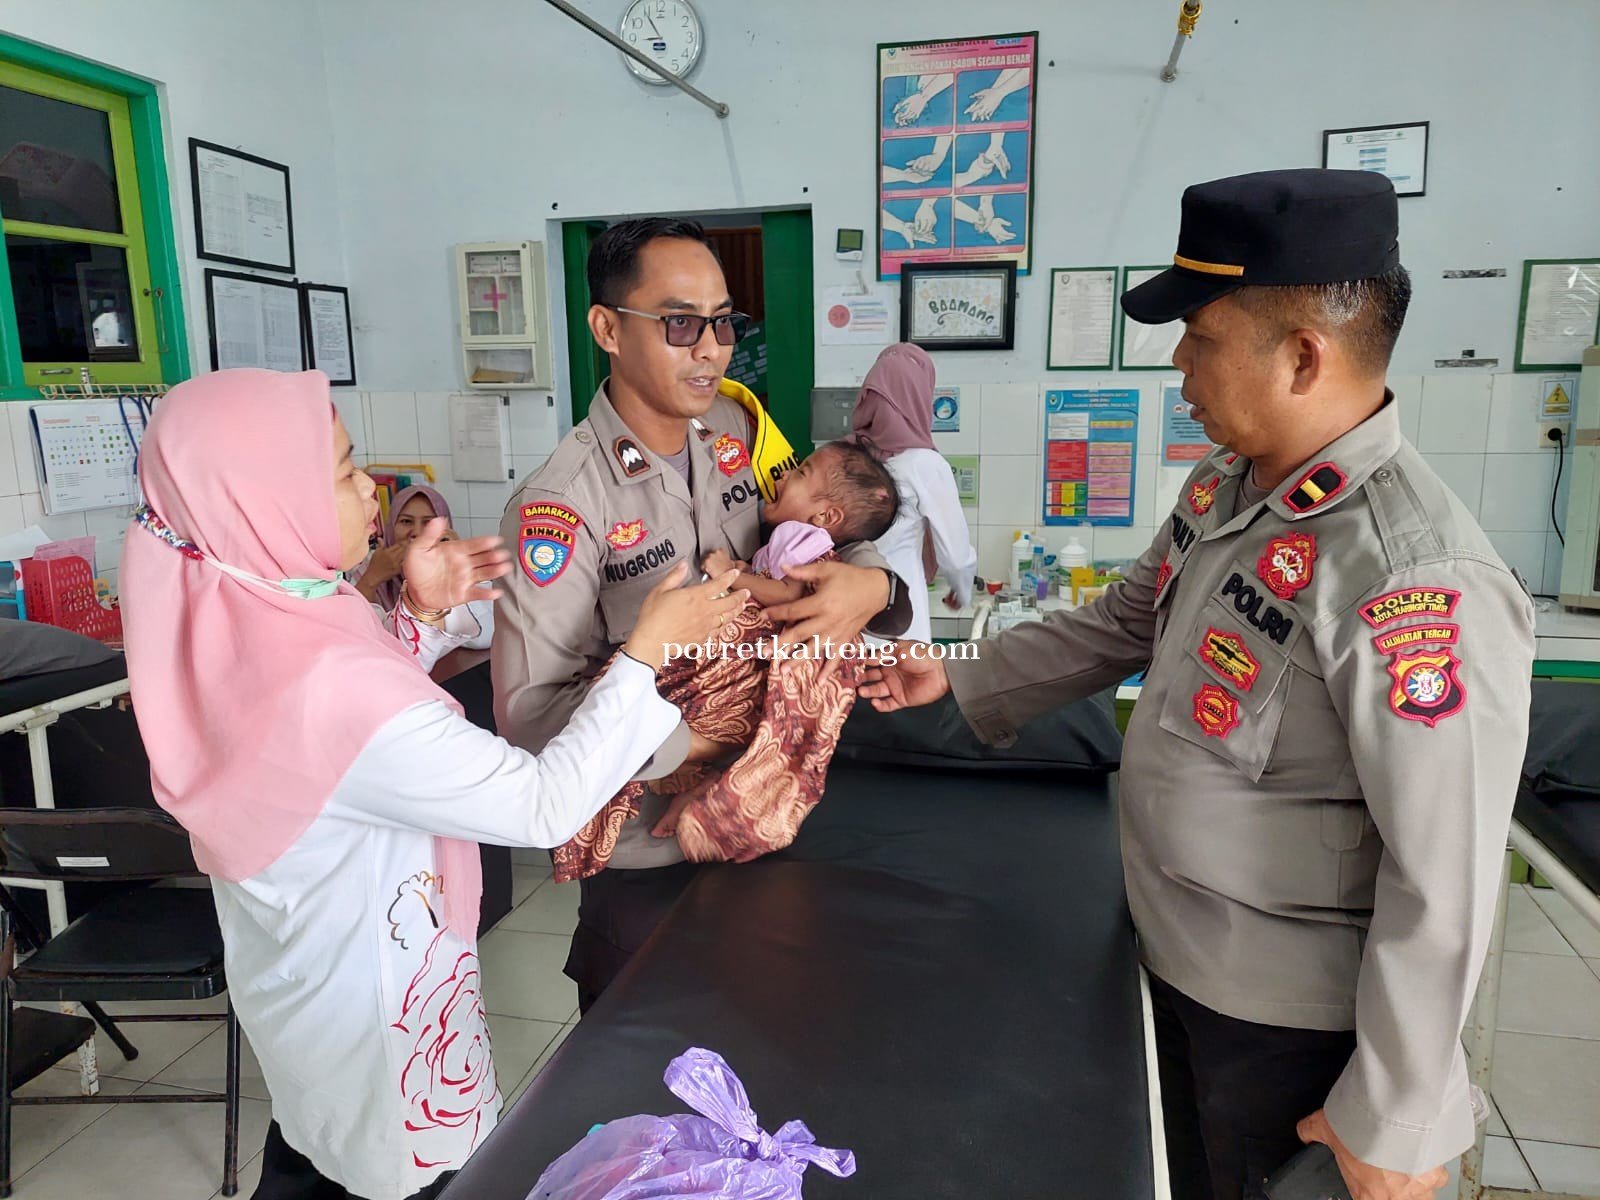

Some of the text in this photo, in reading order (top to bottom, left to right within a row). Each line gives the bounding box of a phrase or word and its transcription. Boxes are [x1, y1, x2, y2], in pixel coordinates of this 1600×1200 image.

[631, 17, 643, 29] 10
[680, 15, 689, 28] 2
[628, 32, 637, 45] 9
[686, 31, 694, 44] 3
[680, 47, 689, 58] 4
[671, 59, 680, 72] 5
[977, 55, 1006, 67] SECARA
[721, 479, 758, 511] POL
[524, 505, 577, 525] BAHARKAM
[526, 527, 569, 542] BINMAS
[605, 538, 676, 583] NUGROHO
[1221, 572, 1294, 645] POLRI
[1372, 592, 1447, 615] POLRES
